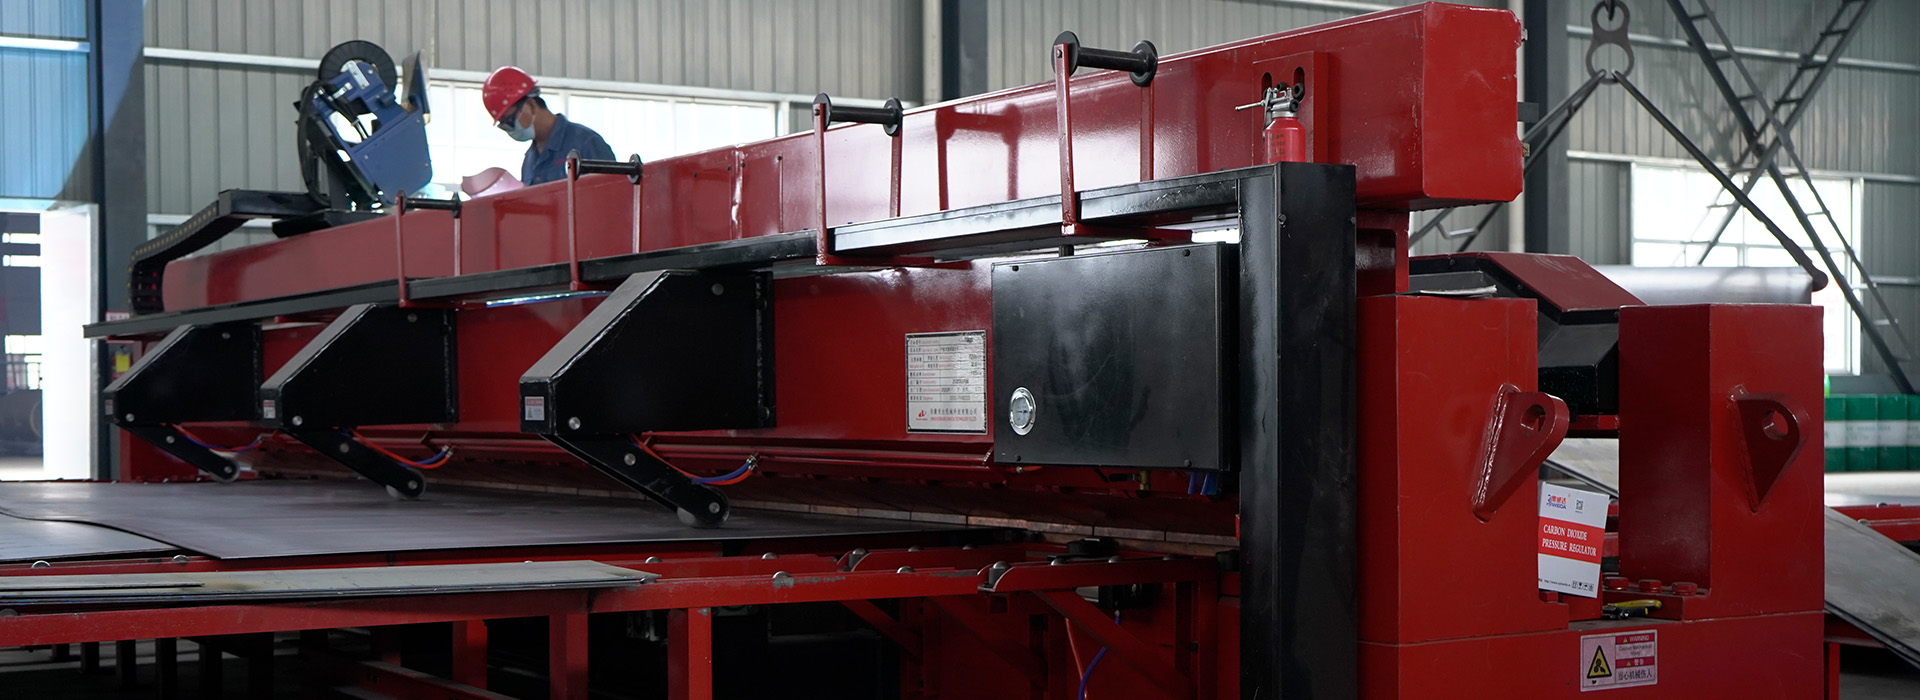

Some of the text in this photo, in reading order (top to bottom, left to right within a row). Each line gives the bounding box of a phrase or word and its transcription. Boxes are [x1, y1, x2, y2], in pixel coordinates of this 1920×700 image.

[1543, 524, 1587, 540] CARBON DIOXIDE
[1542, 538, 1597, 556] PRESSURE REGULATOR
[1618, 669, 1652, 680] 当心机械伤人
